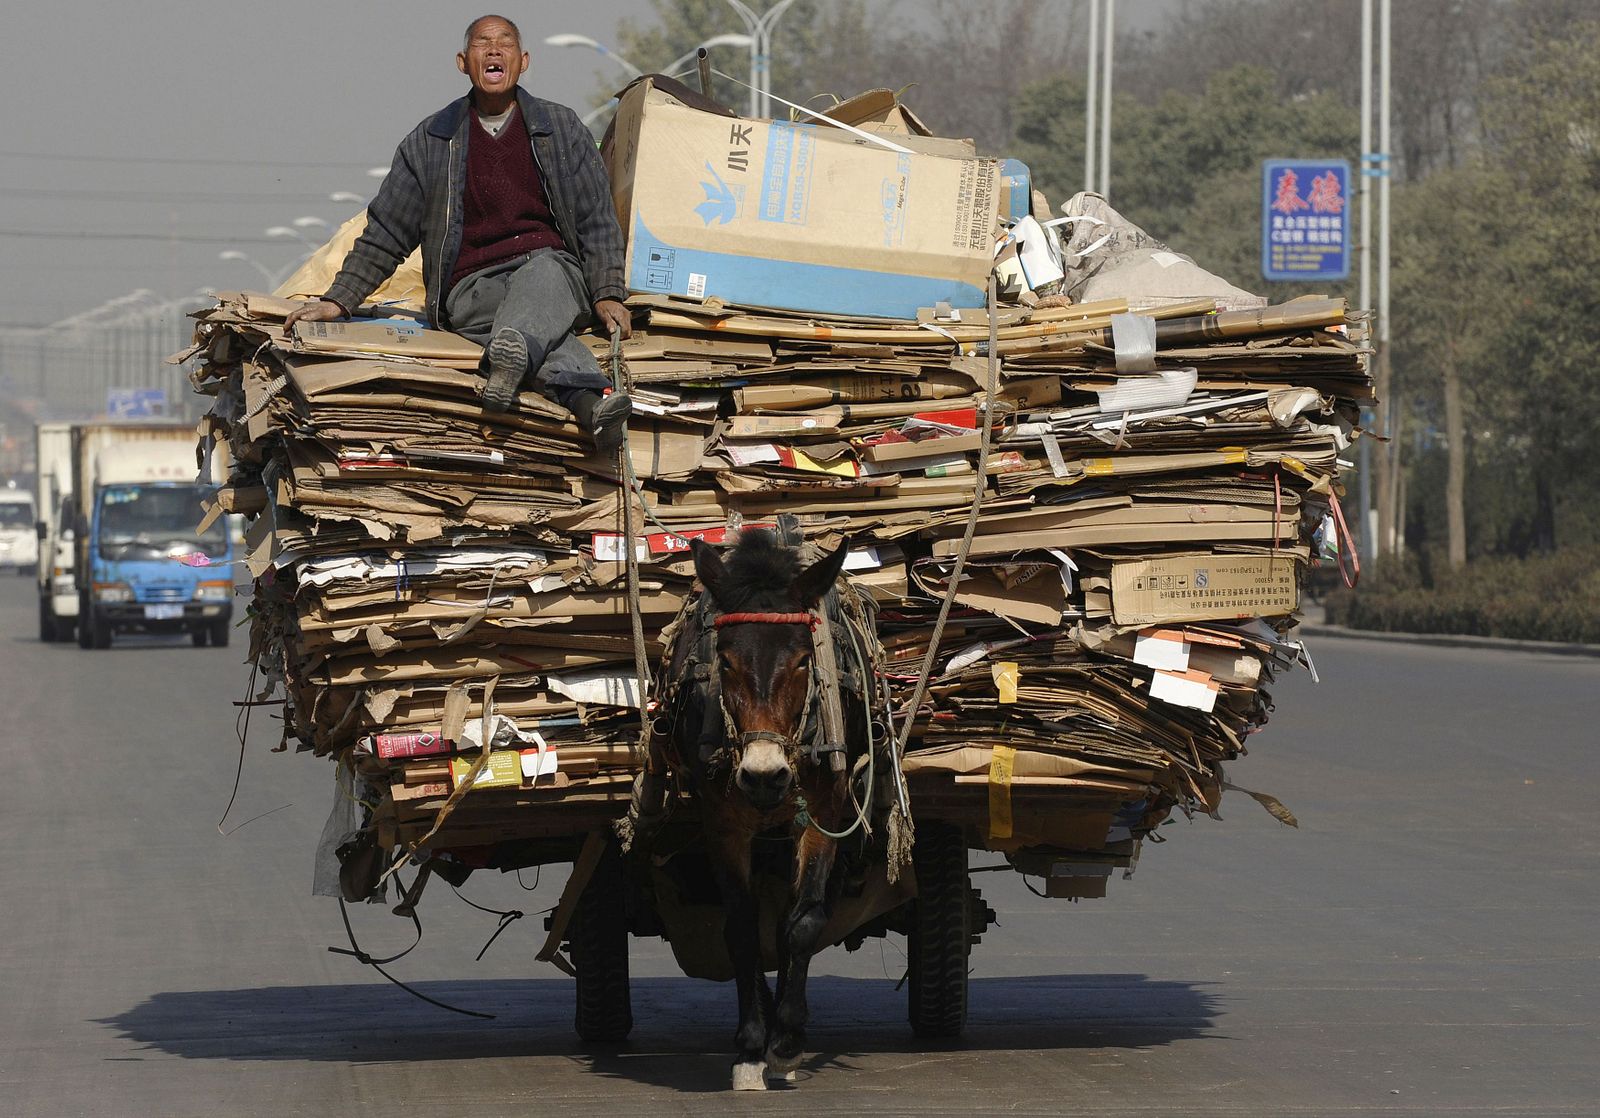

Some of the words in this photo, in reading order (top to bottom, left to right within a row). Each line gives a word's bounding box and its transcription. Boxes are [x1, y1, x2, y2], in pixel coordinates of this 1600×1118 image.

[727, 124, 753, 172] 小天
[984, 193, 992, 211] SWAN
[981, 212, 989, 233] LITTLE
